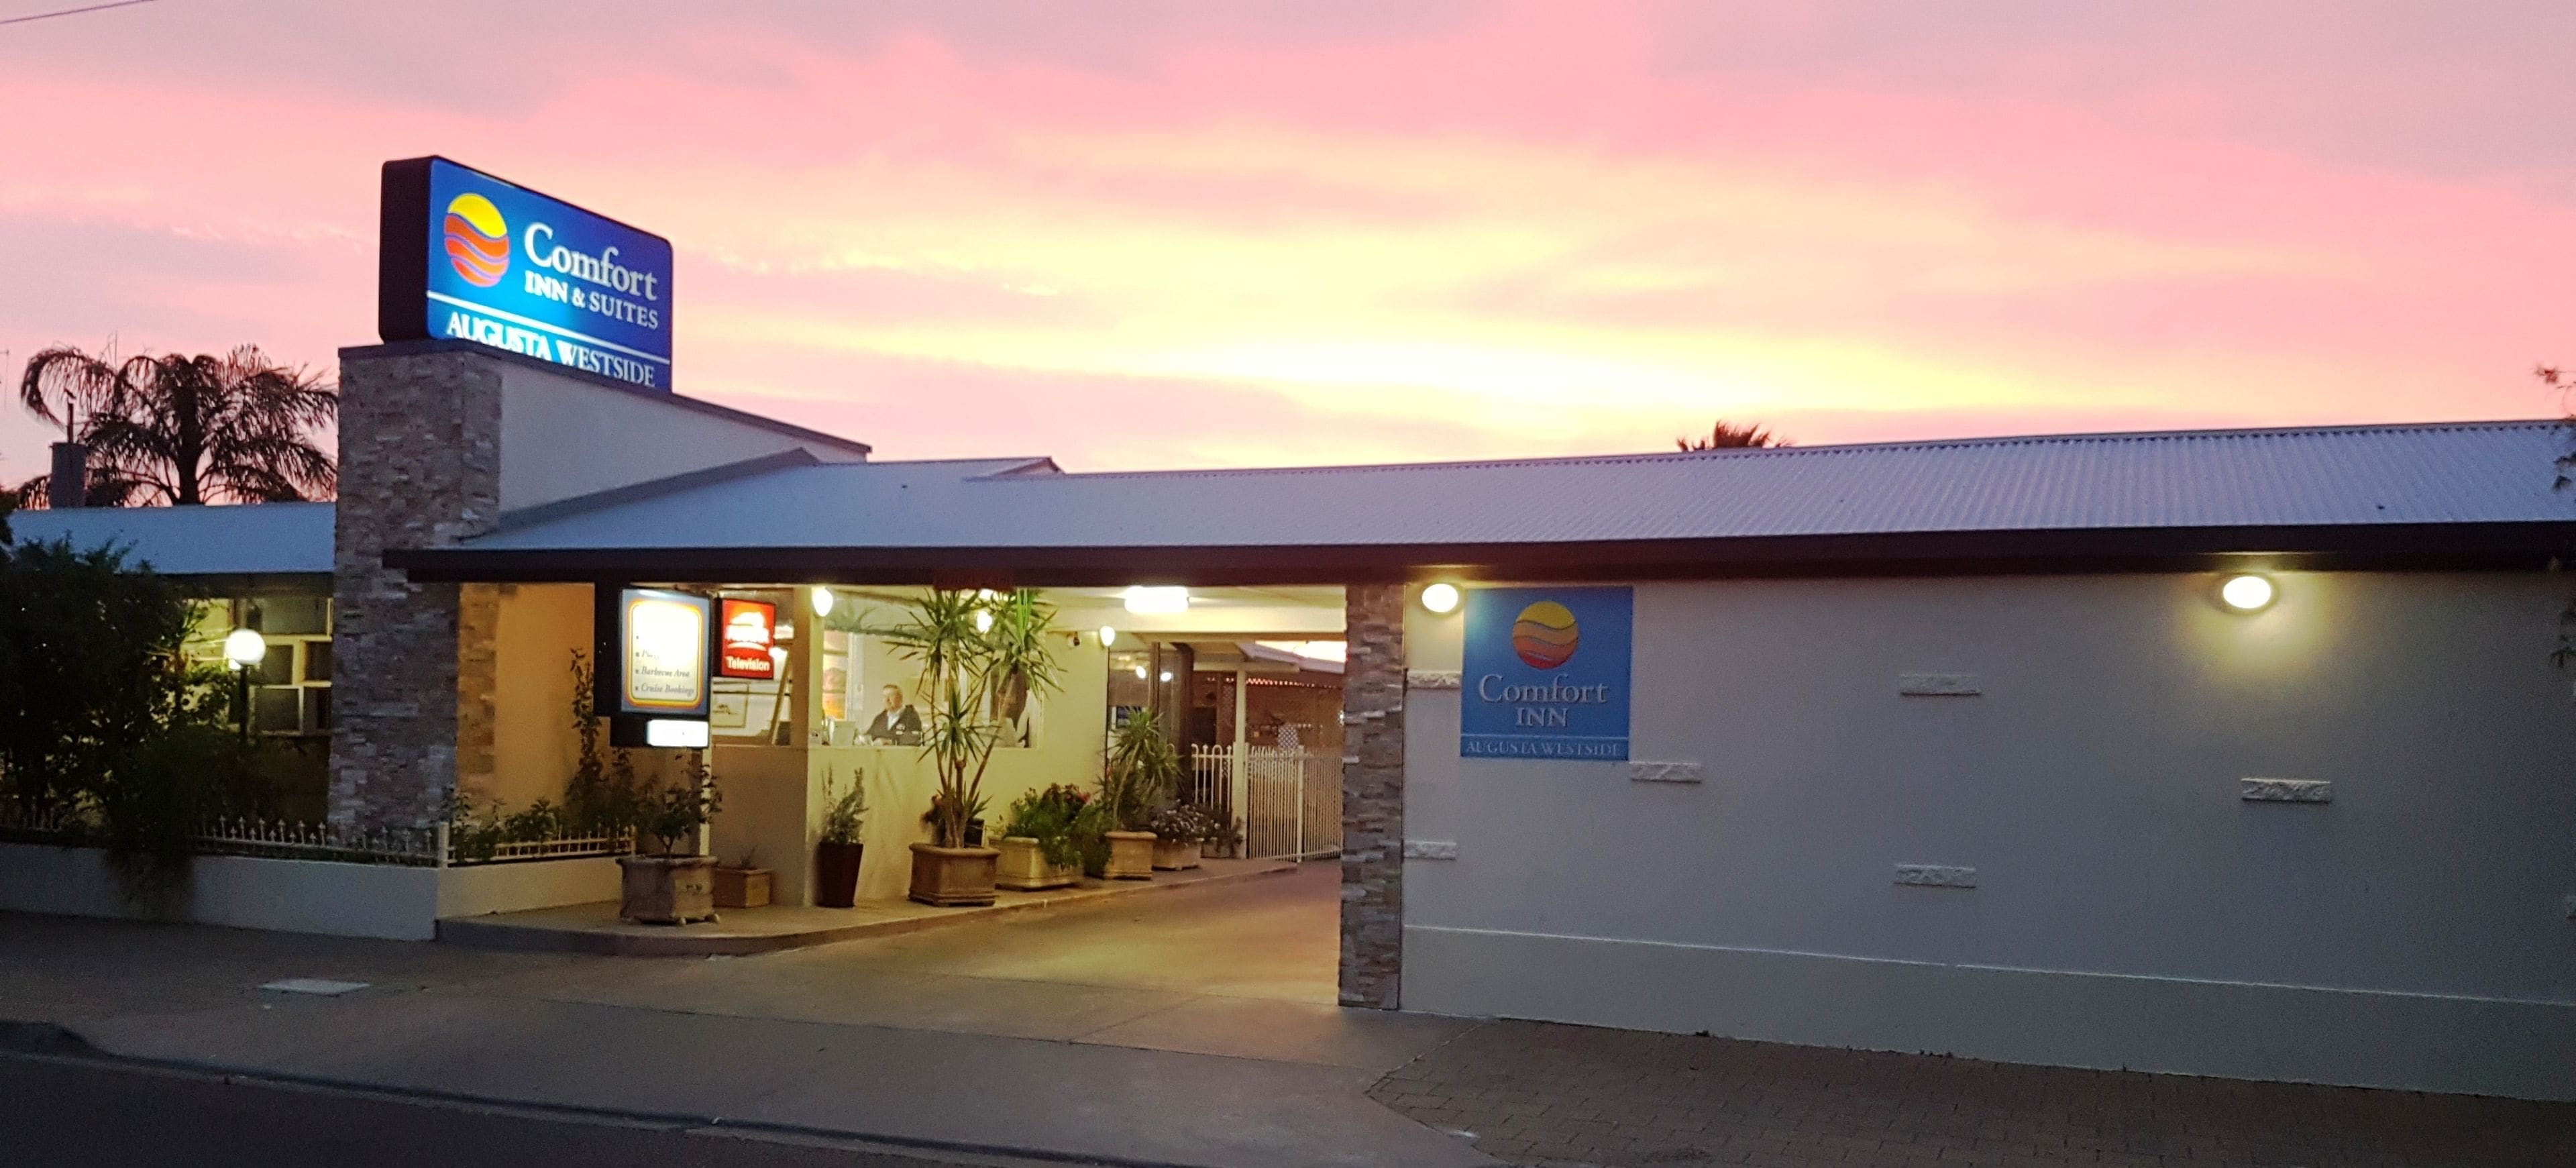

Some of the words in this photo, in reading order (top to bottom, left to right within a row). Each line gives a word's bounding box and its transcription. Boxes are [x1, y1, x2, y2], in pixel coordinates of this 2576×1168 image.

[523, 222, 658, 301] Comfort
[524, 270, 569, 304] INN
[572, 287, 586, 309] &
[588, 291, 659, 331] SUITES
[446, 311, 551, 362] AUGUSTA
[556, 339, 655, 388] WESTSIDE
[641, 666, 672, 677] Barbecue
[724, 656, 771, 672] Television
[641, 683, 663, 692] Cruise
[665, 684, 694, 697] Bookings
[1479, 674, 1608, 703] Comfort
[1515, 707, 1568, 727] INN
[1467, 739, 1537, 753] AUGUSTA
[1542, 742, 1620, 756] WESTSIDE
